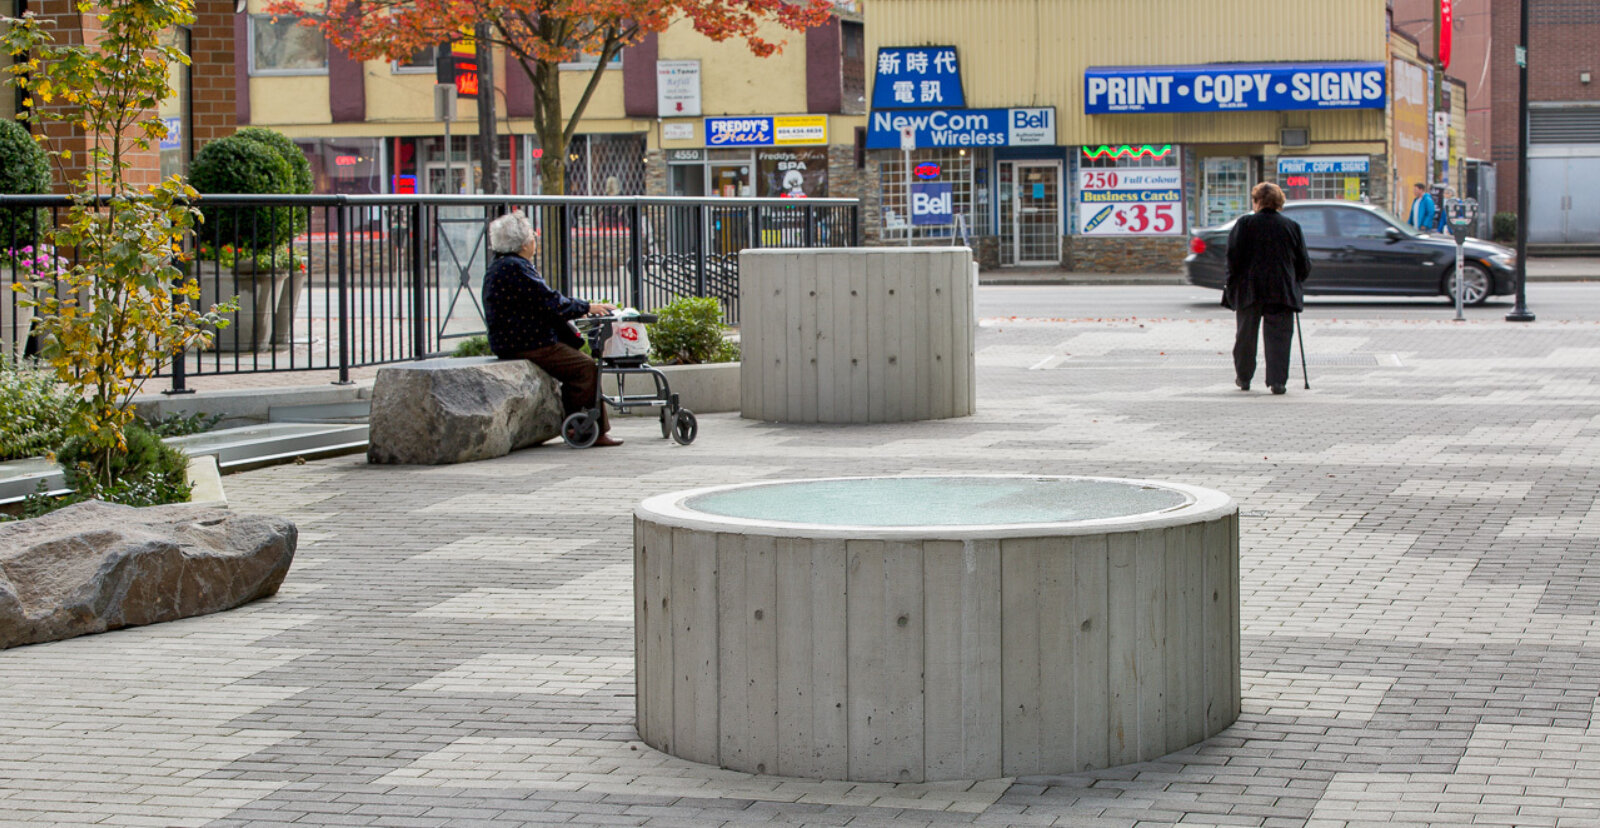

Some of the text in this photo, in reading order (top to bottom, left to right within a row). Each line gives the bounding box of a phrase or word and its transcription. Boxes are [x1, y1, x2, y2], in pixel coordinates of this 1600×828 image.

[878, 51, 956, 75] 新時代
[892, 81, 943, 103] 電訊
[1088, 71, 1382, 105] PRINT COPY SIGNS
[711, 119, 769, 133] FREDDY'S
[874, 110, 989, 132] NewCom
[1014, 110, 1049, 129] Bell
[711, 130, 770, 144] Hair
[930, 130, 1005, 146] Wireless
[335, 155, 357, 165] OPEN
[674, 151, 699, 160] 4550
[777, 161, 807, 171] SPA
[913, 165, 941, 176] OPEN
[1282, 160, 1366, 172] PRINT COPY SIGNS
[1084, 172, 1178, 189] 250 Full Colour
[1287, 176, 1310, 187] OPEN
[1084, 190, 1179, 201] Business Cards
[912, 192, 951, 215] Bell
[1115, 204, 1174, 232] $35
